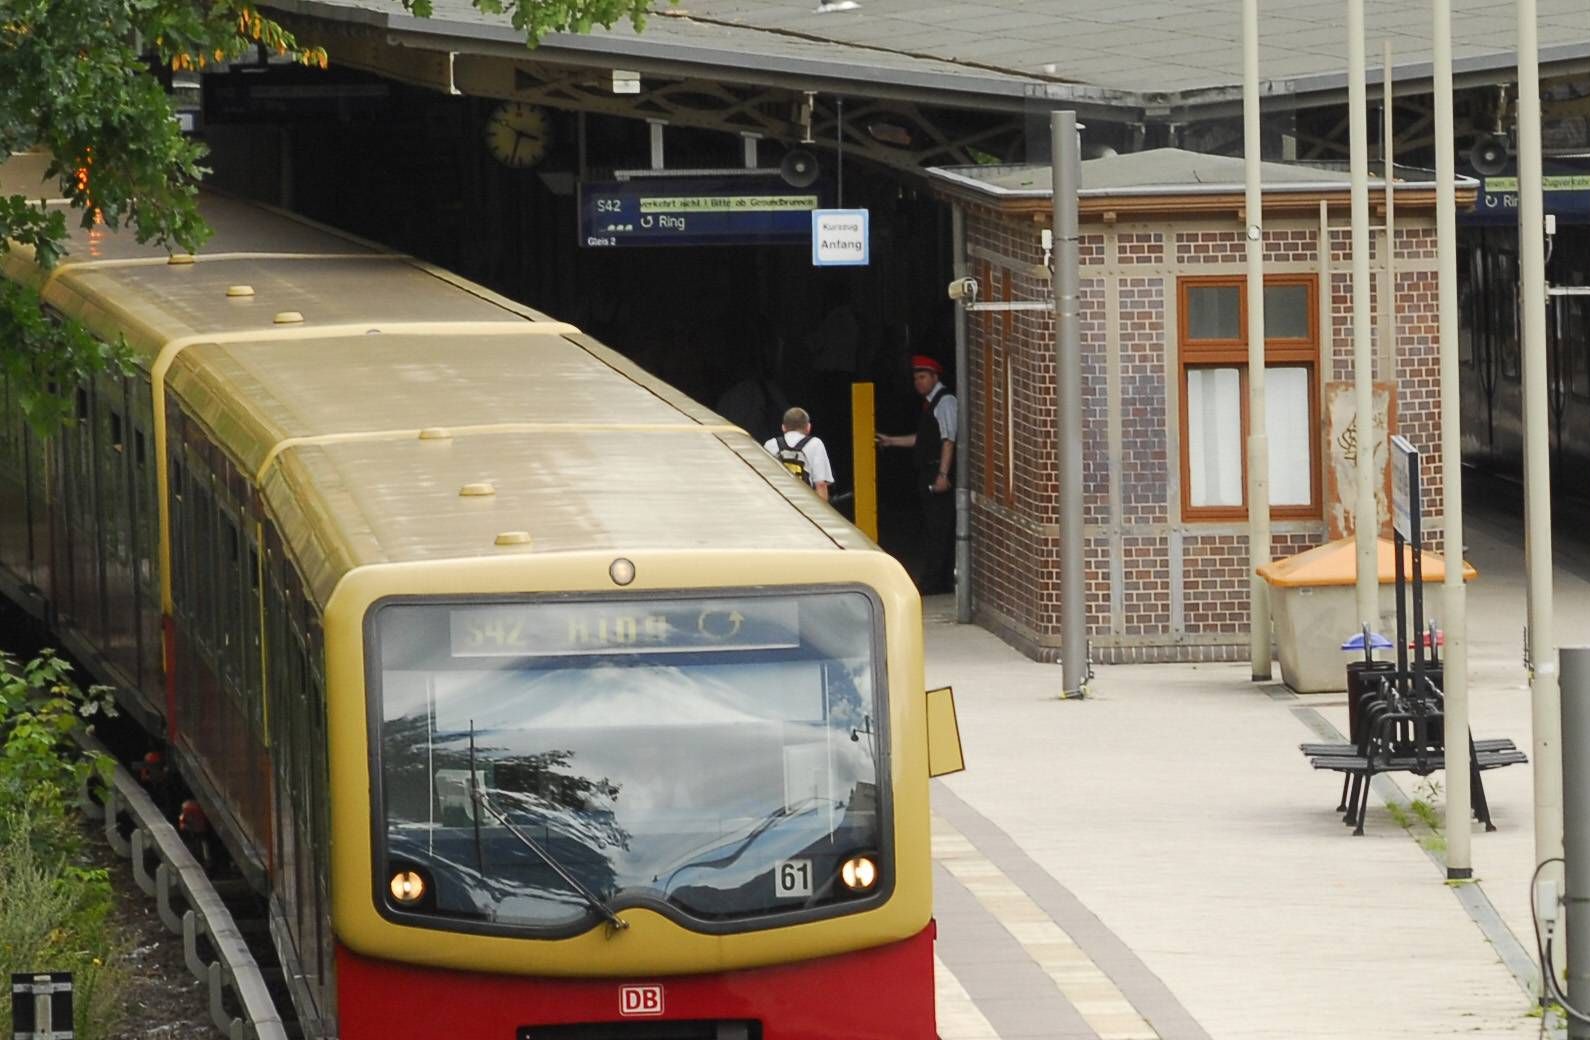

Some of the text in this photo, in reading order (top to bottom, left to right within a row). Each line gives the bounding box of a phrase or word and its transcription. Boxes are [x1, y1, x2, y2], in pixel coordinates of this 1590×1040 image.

[597, 199, 622, 212] S42
[1503, 194, 1519, 208] Rin
[658, 214, 685, 231] Ring
[610, 236, 617, 247] 2
[821, 239, 863, 252] Anfang
[467, 616, 527, 647] S42
[781, 862, 808, 891] 61
[625, 989, 658, 1009] DB
